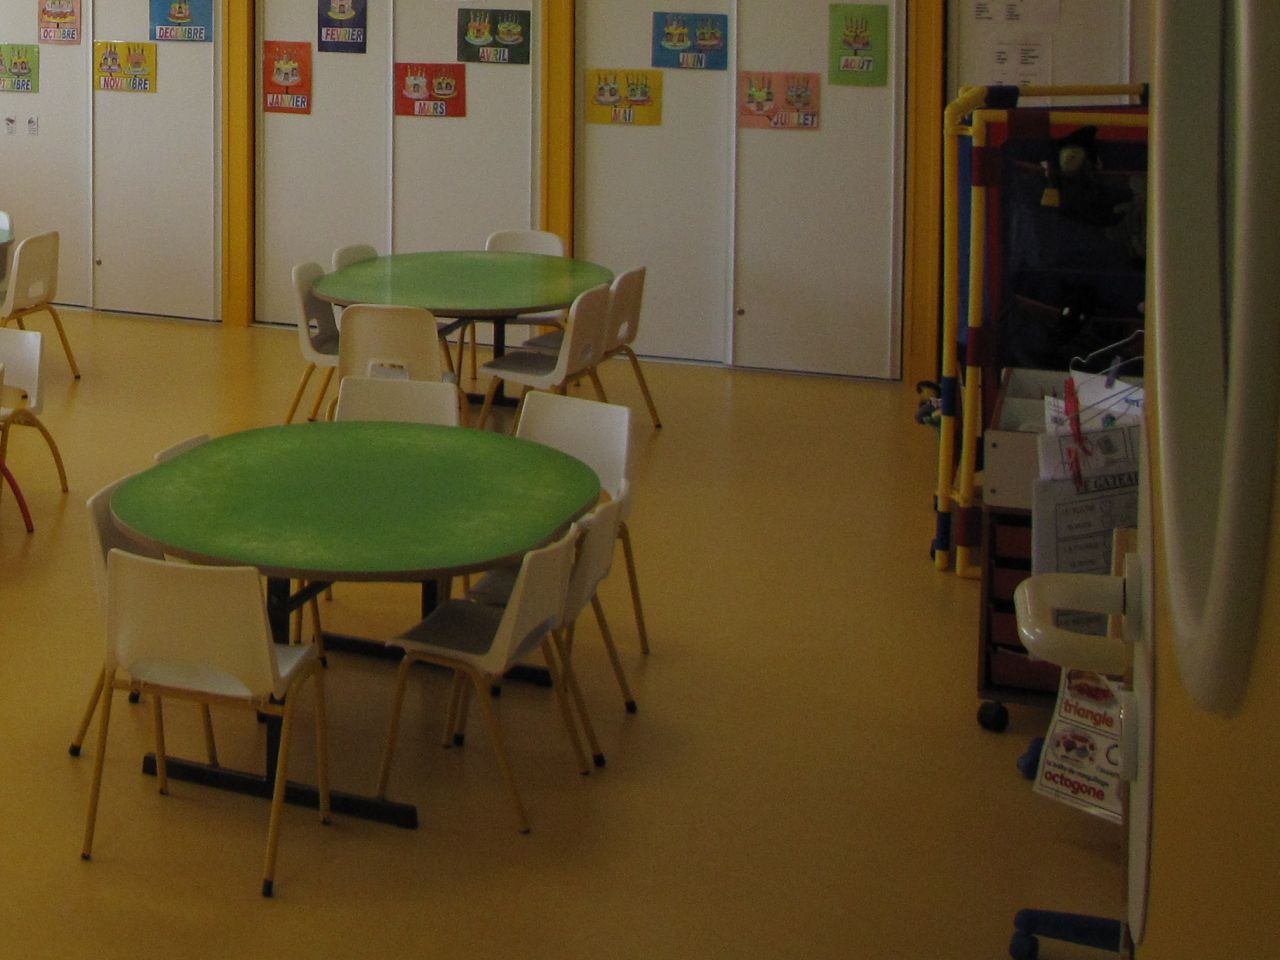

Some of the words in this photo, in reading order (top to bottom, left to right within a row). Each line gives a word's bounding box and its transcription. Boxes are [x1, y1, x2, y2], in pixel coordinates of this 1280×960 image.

[43, 28, 76, 40] OCTOBRE
[158, 26, 205, 40] DECEMBRE
[324, 28, 363, 41] FEVRIER
[480, 47, 508, 62] AVRIL
[268, 94, 307, 108] JANVIER
[417, 101, 446, 115] MARS
[1063, 699, 1114, 728] triangle
[1044, 771, 1106, 801] octogone
